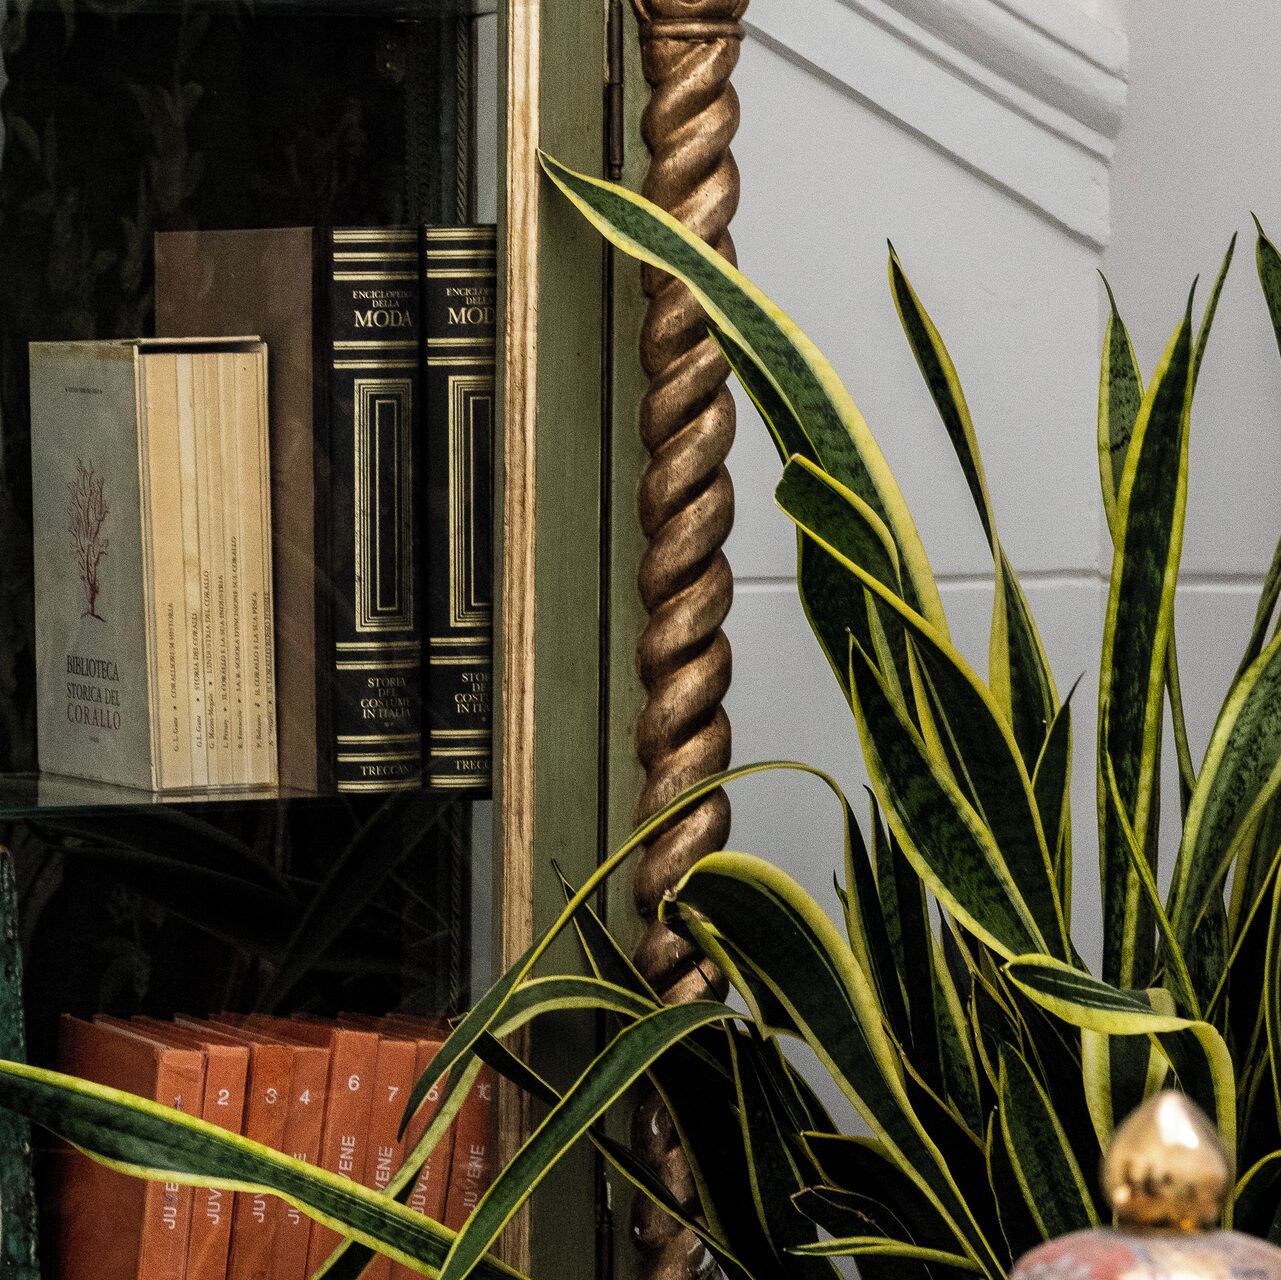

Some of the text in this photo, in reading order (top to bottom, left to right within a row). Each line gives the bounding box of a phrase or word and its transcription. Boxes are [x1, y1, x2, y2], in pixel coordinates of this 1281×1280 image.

[372, 299, 400, 308] DELLA
[354, 309, 412, 328] MODA
[448, 306, 495, 325] MOD
[205, 624, 213, 674] L'INDUSTRIA
[66, 655, 120, 681] BIBLIOTECA
[367, 677, 406, 688] STORIA
[472, 682, 485, 692] DE
[66, 682, 120, 707] STORICA DEL
[378, 688, 395, 698] DEL
[360, 697, 411, 709] COSTUME
[456, 703, 469, 714] IN
[67, 703, 121, 730] CORALLO
[362, 708, 411, 719] IN ITALIA
[348, 1074, 361, 1091] 6
[174, 1094, 182, 1111] 1
[217, 1089, 230, 1105] 2
[265, 1088, 277, 1104] 3
[299, 1089, 310, 1105] 4
[387, 1086, 399, 1103] 7
[163, 1183, 179, 1229] JUVE
[207, 1187, 222, 1225] JUV
